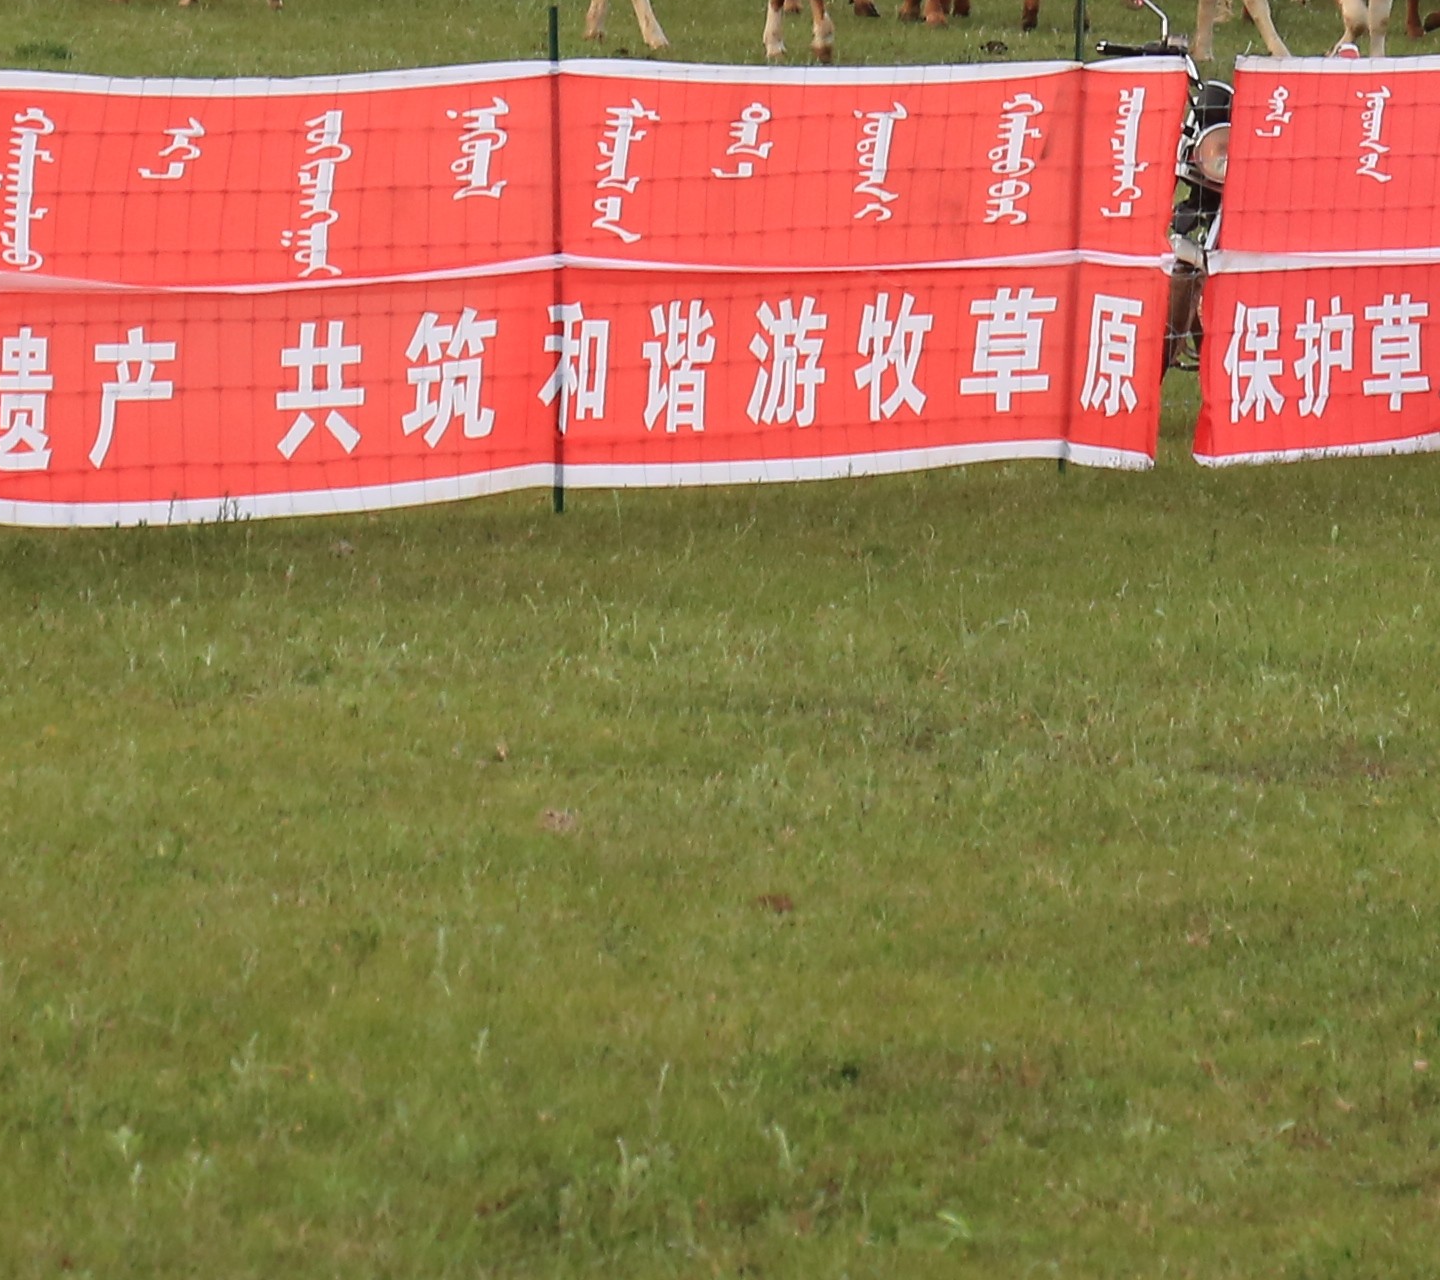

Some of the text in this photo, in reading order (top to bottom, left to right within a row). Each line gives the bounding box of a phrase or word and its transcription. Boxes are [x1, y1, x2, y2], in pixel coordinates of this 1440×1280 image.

[274, 286, 1145, 460] 共筑和谐游牧草原
